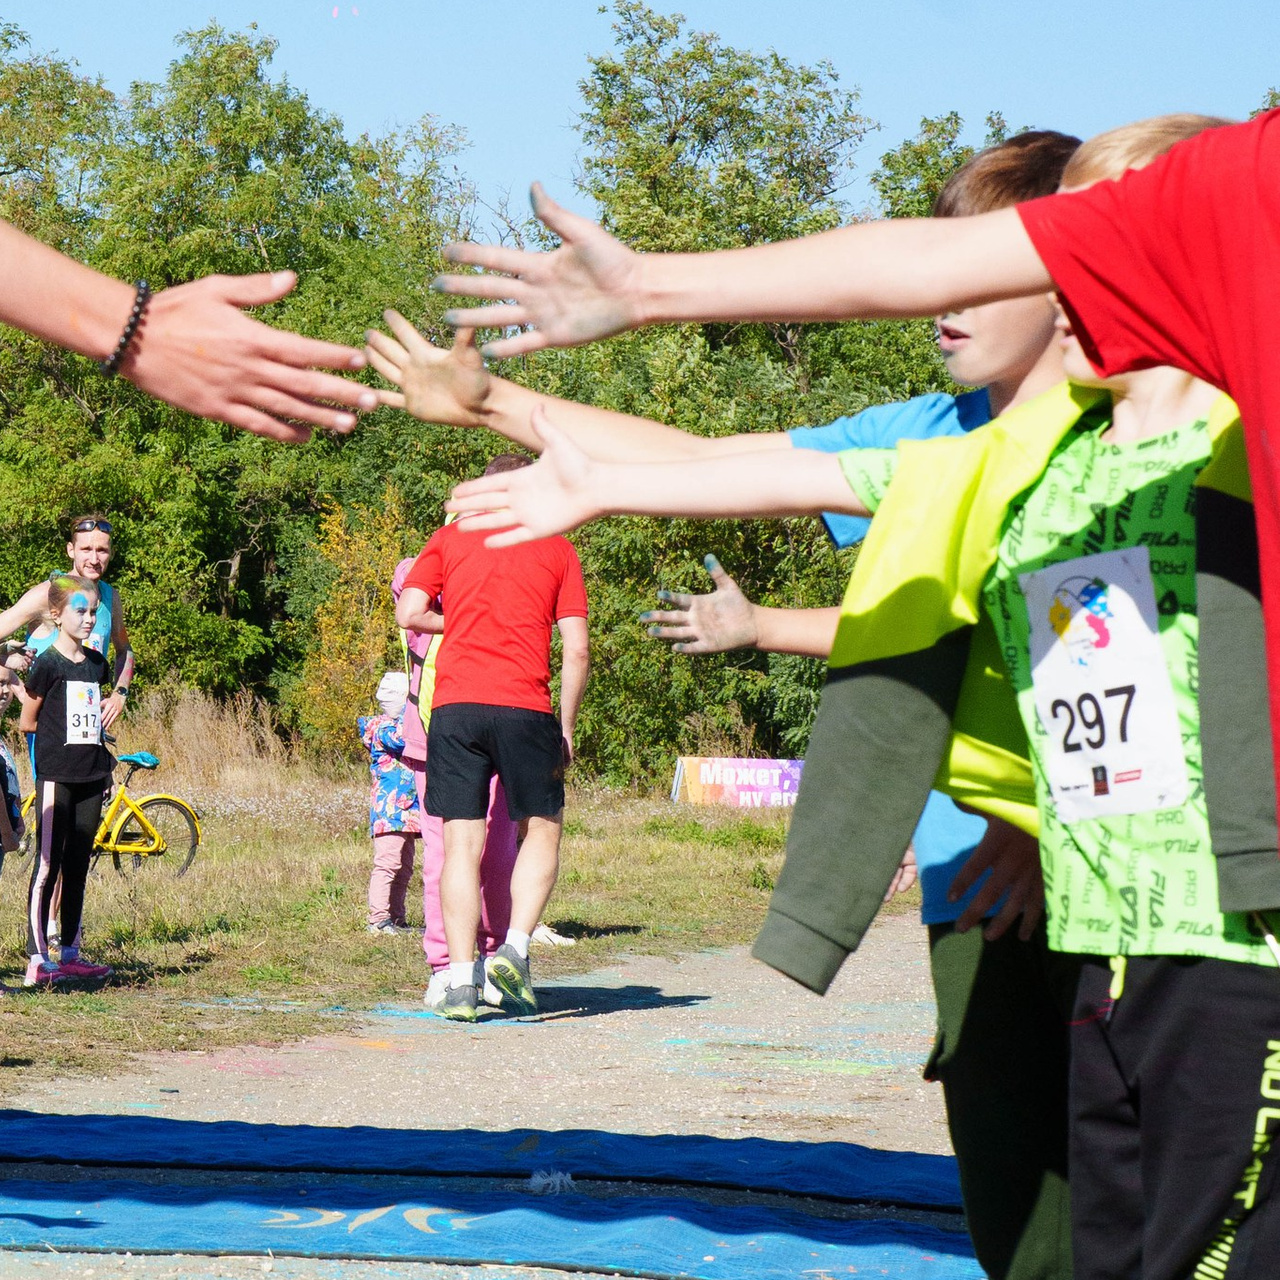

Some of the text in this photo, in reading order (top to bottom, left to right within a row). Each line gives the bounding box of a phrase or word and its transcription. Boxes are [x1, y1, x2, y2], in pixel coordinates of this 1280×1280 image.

[1051, 684, 1136, 753] 297
[700, 763, 790, 790] Может,
[1155, 810, 1185, 827] PRO
[1149, 870, 1165, 928] FILA
[1174, 921, 1214, 936] FILA
